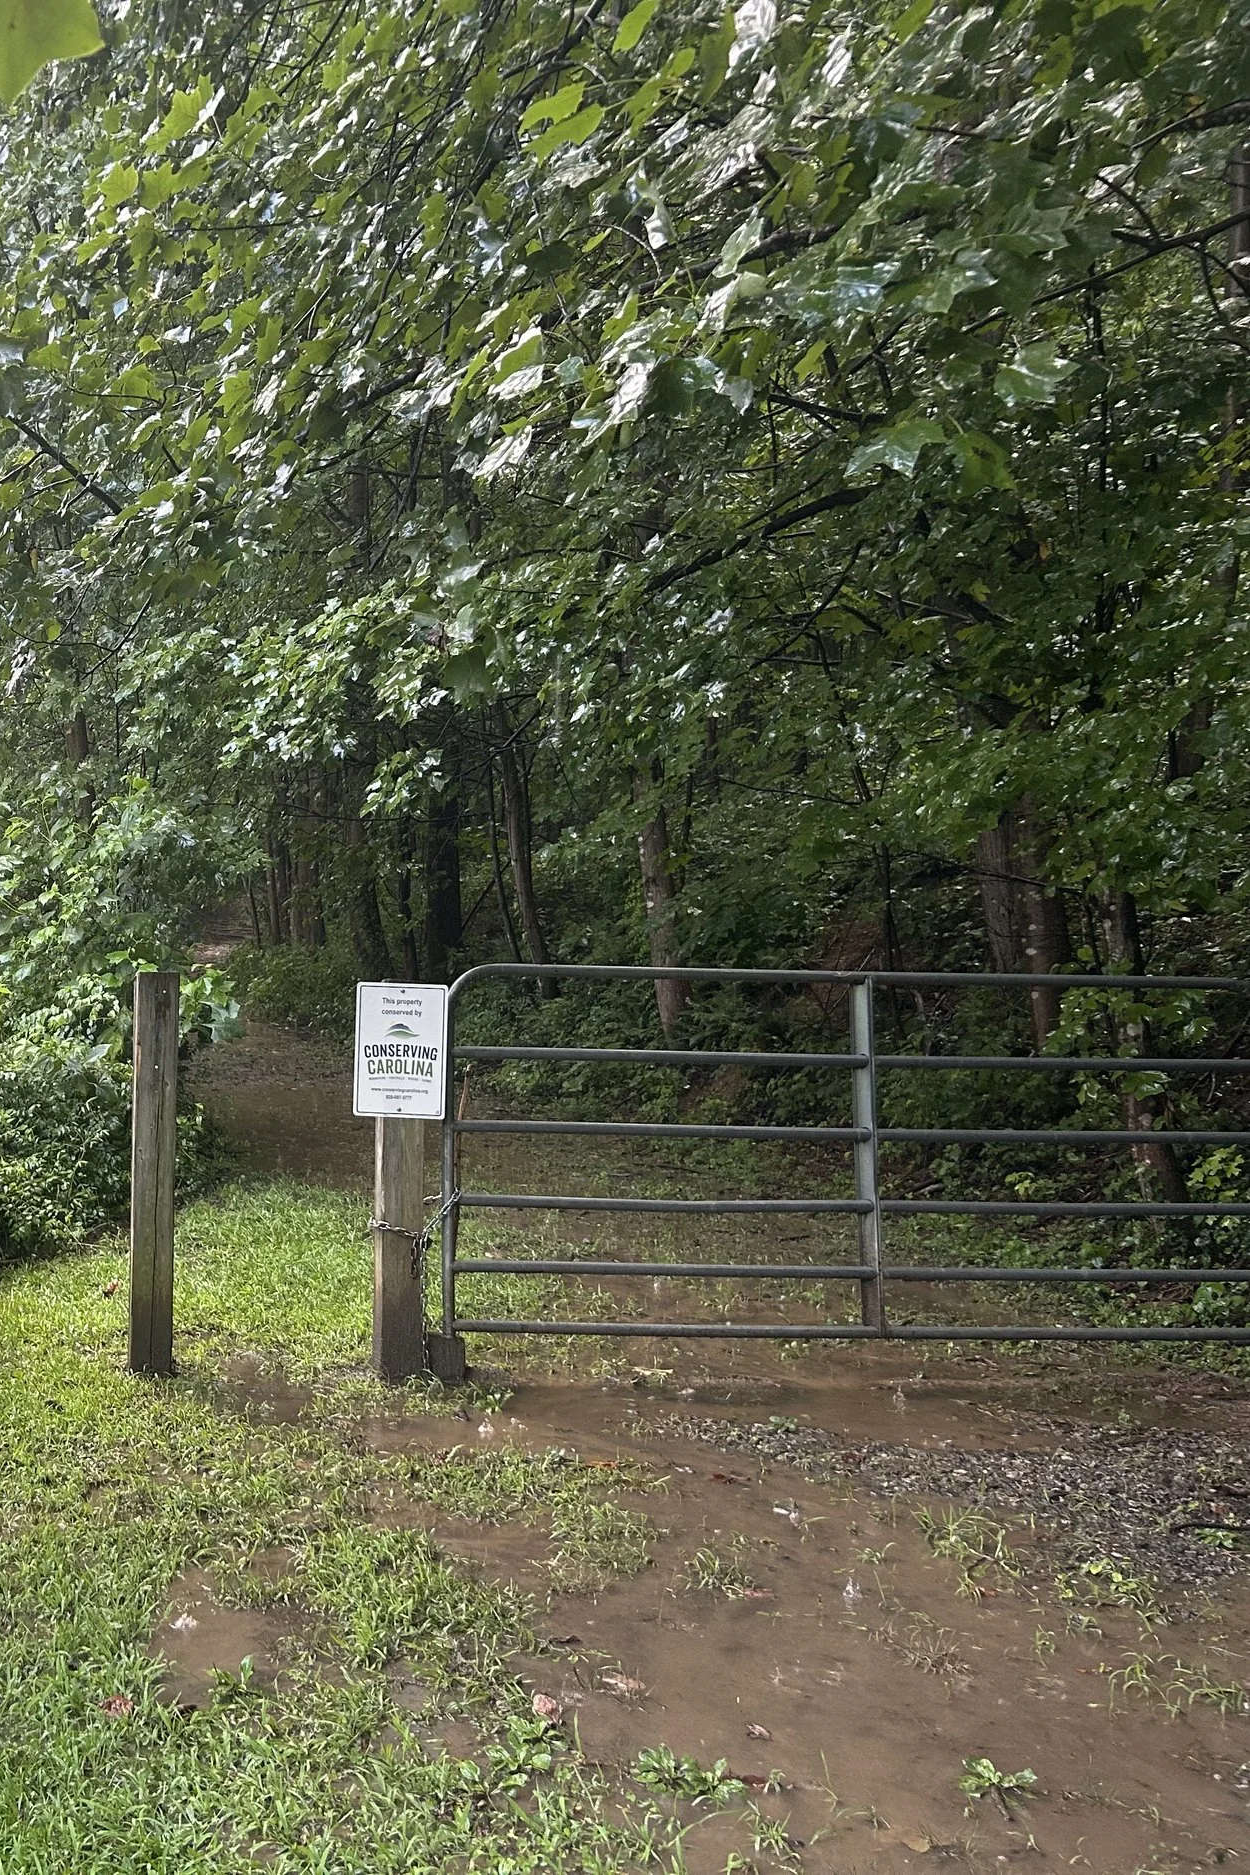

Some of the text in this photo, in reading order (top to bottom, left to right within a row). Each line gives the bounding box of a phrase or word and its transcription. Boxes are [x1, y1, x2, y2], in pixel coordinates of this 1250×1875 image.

[382, 997, 423, 1007] This property
[414, 1009, 422, 1017] by
[364, 1043, 438, 1061] CONSERVING
[367, 1059, 433, 1078] CAROLINA
